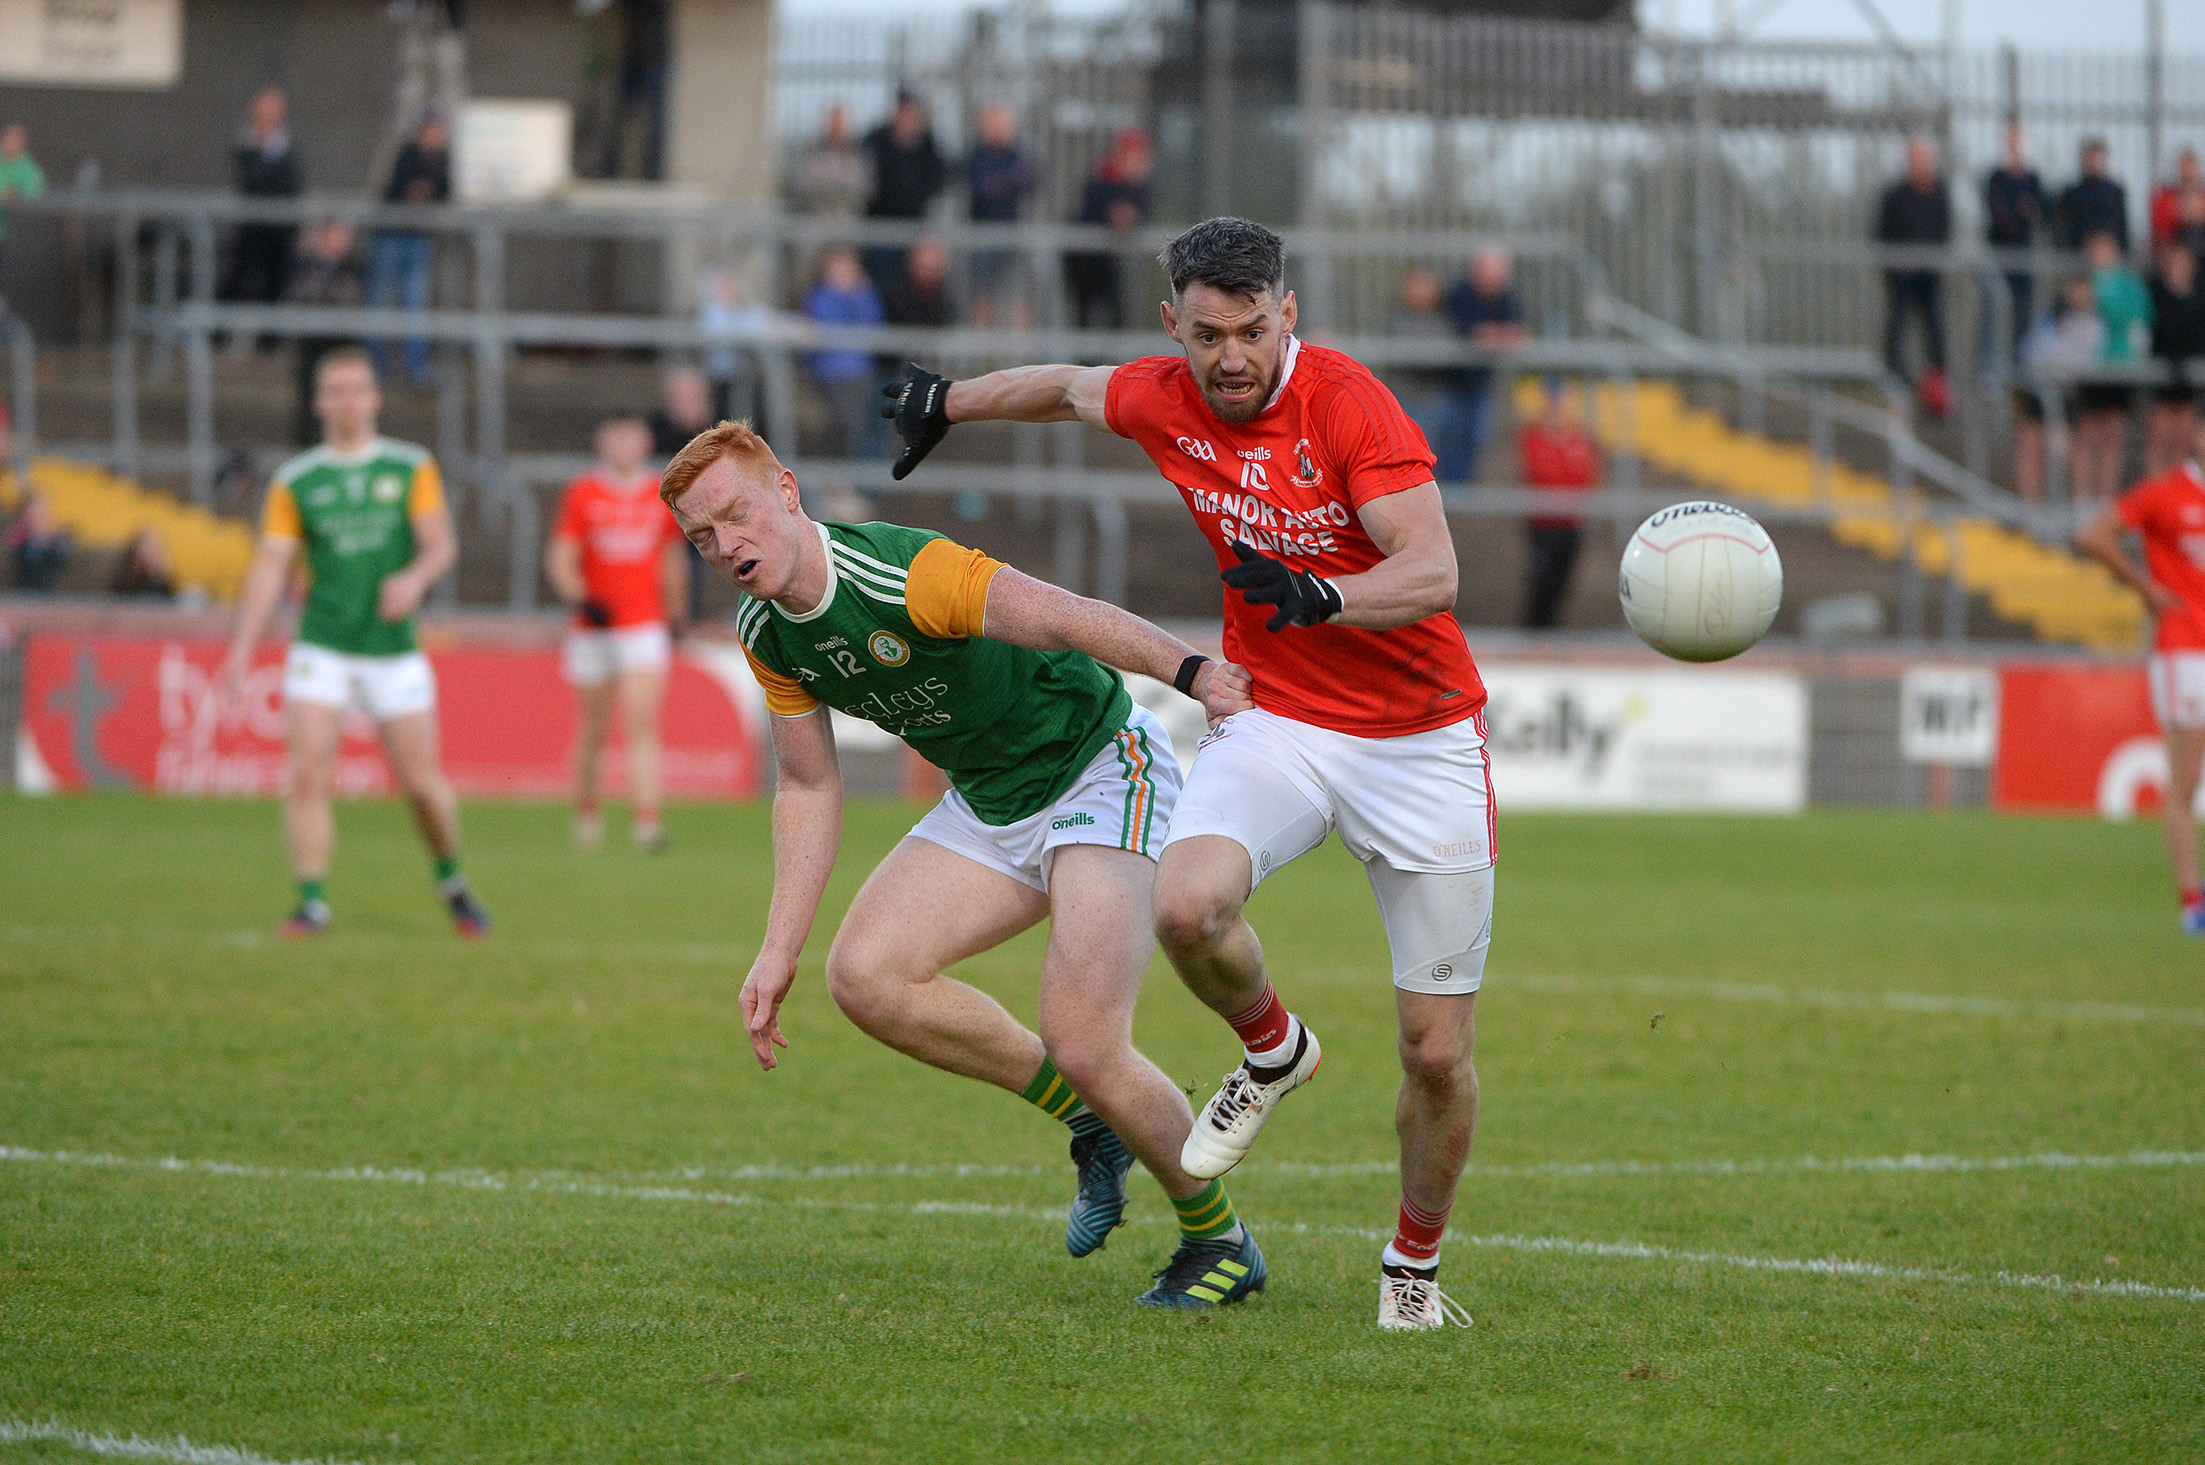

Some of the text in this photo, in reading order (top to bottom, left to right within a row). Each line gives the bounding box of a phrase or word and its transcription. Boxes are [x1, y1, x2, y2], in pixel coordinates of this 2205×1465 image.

[1240, 460, 1271, 491] 10
[1187, 487, 1350, 530] MANOR AUTO
[1220, 518, 1339, 556] SALVAGE
[827, 650, 867, 679] 12
